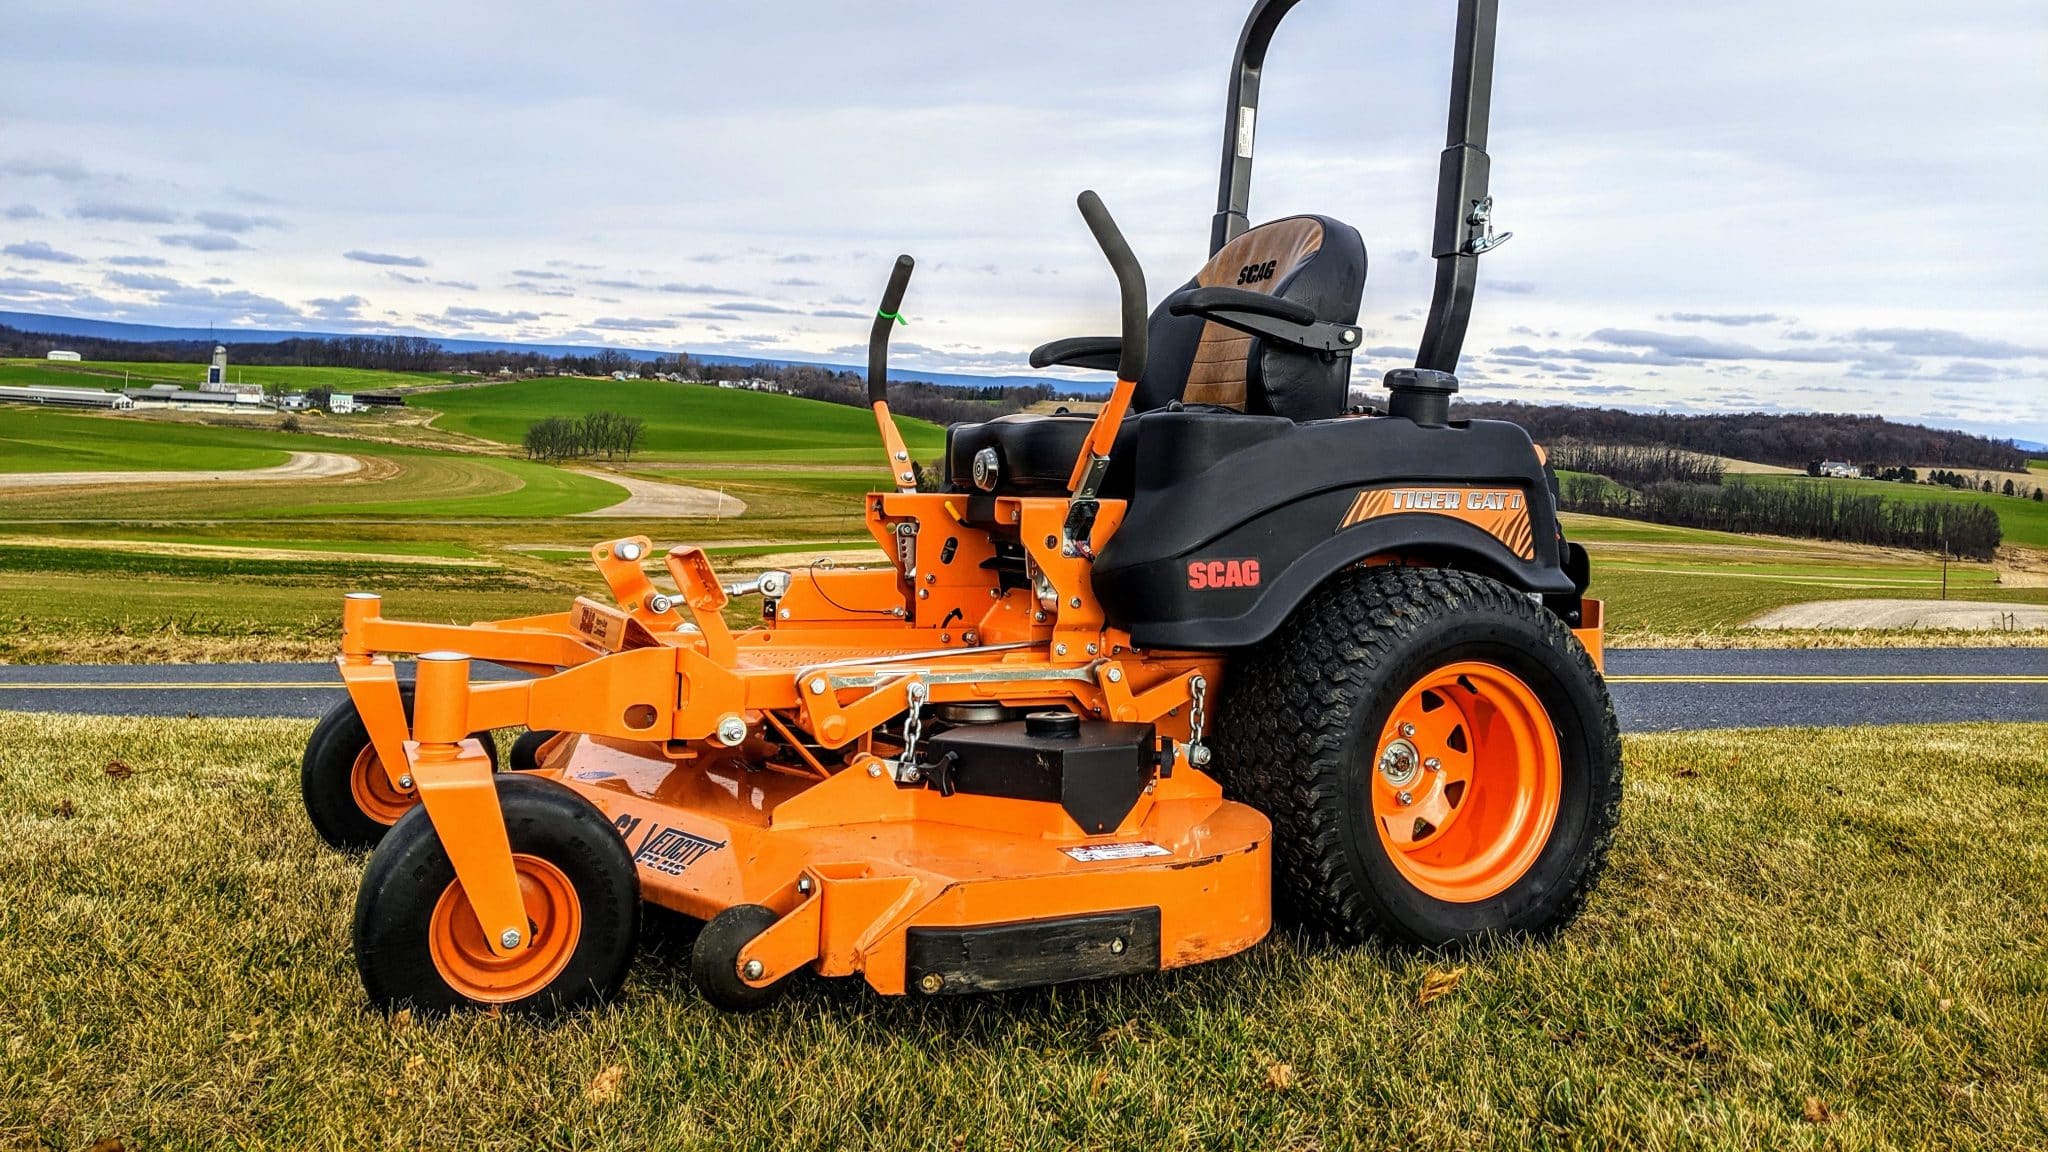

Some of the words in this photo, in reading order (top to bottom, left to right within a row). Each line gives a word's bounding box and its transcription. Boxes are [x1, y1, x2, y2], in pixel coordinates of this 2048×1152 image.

[1237, 260, 1277, 286] SCAG
[1390, 490, 1461, 510] TIGER
[1466, 491, 1509, 511] CAT
[1187, 559, 1260, 590] SCAG
[633, 823, 728, 867] VELOCITY
[636, 852, 686, 876] PLUS
